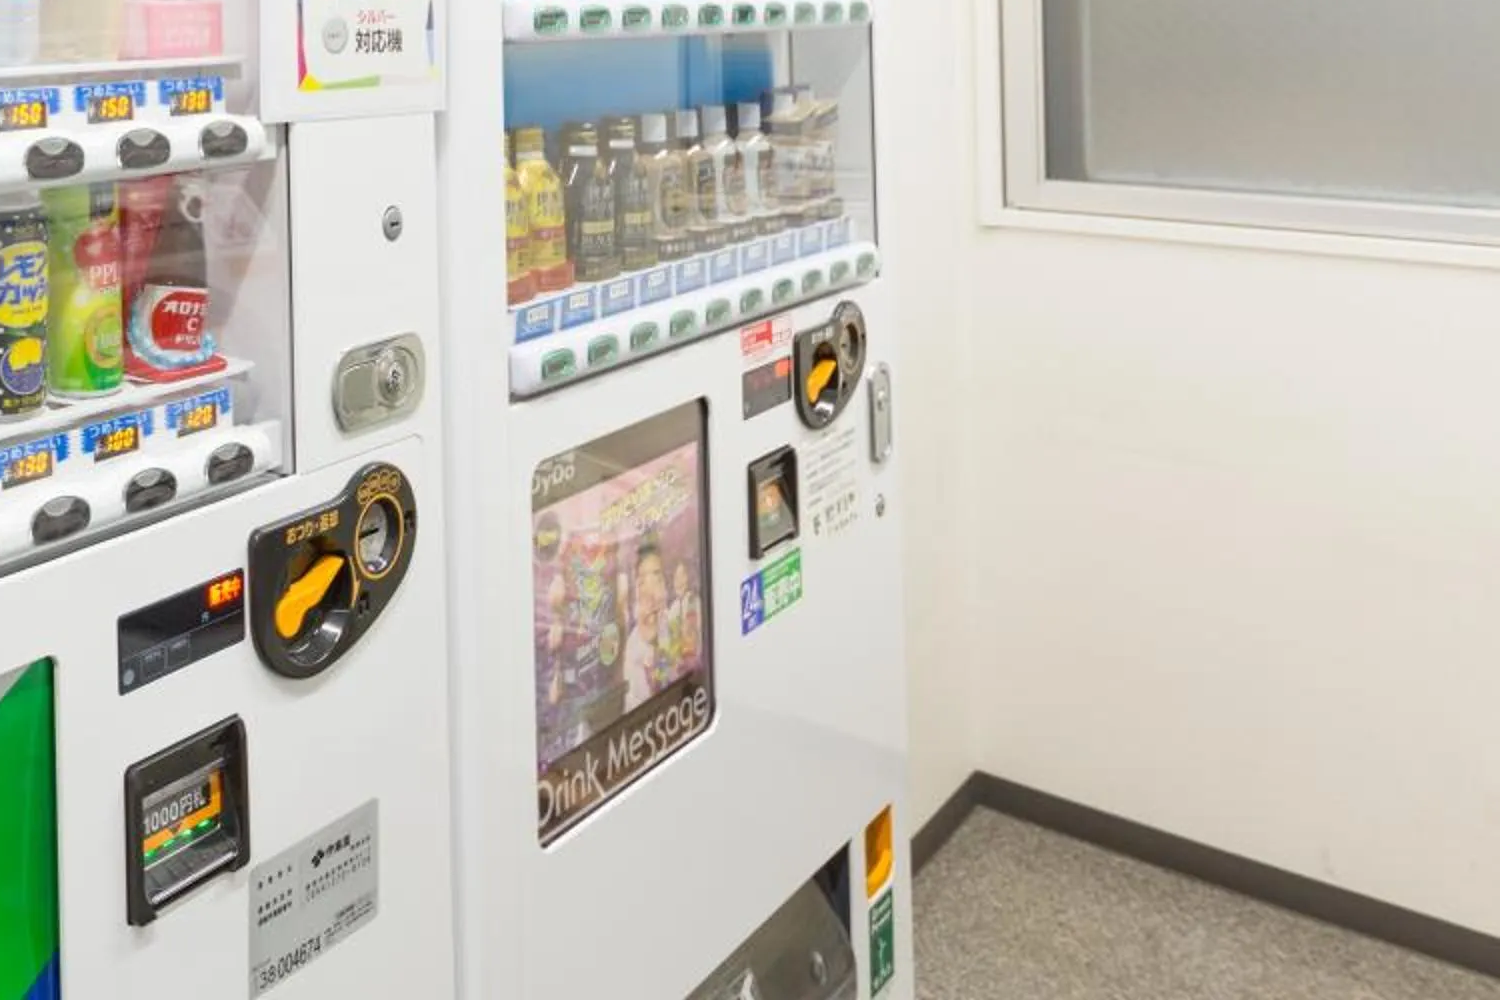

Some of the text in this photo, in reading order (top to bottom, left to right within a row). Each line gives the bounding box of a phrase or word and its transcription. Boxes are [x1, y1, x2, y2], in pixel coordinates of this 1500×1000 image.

[356, 9, 396, 25] シルバー
[355, 27, 404, 54] 対応機
[537, 687, 707, 828] Drink Message
